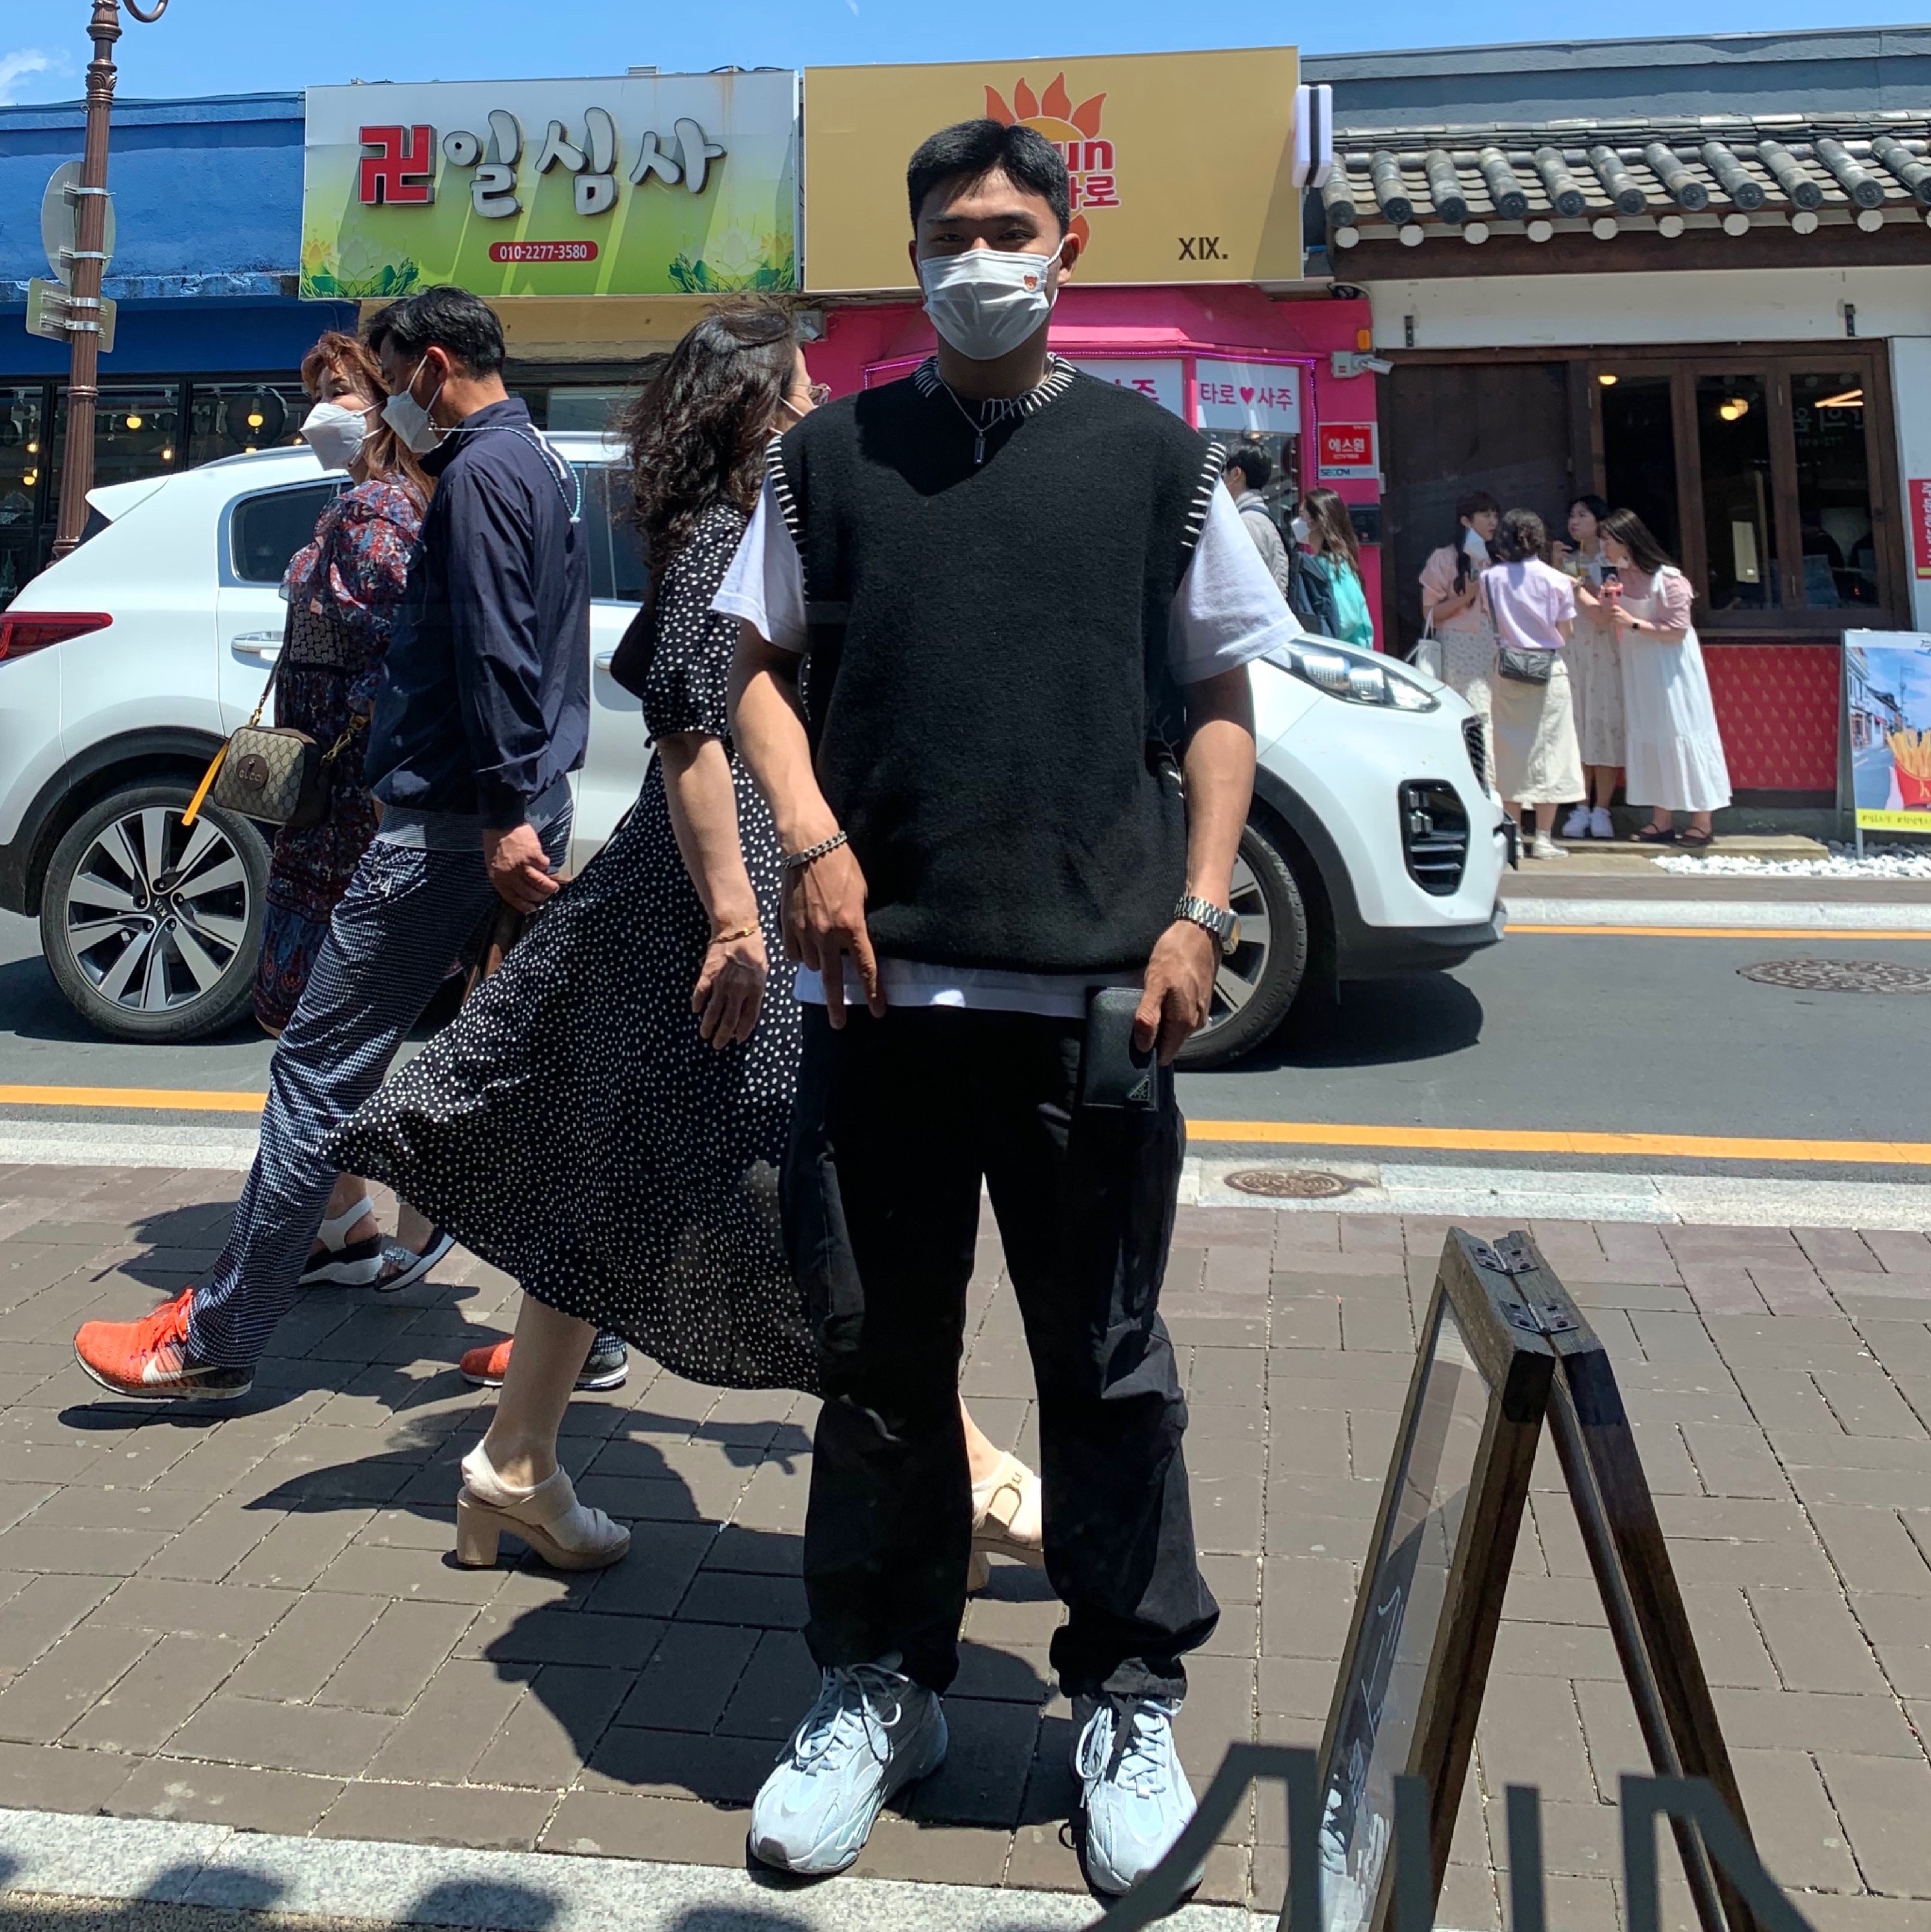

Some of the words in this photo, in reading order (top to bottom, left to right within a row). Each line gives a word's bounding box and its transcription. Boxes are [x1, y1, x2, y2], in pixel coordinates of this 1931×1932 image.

[1051, 140, 1115, 172] un
[500, 244, 587, 260] 010-2277-3580
[1178, 236, 1229, 260] XIX.
[1328, 437, 1366, 453] 에스원
